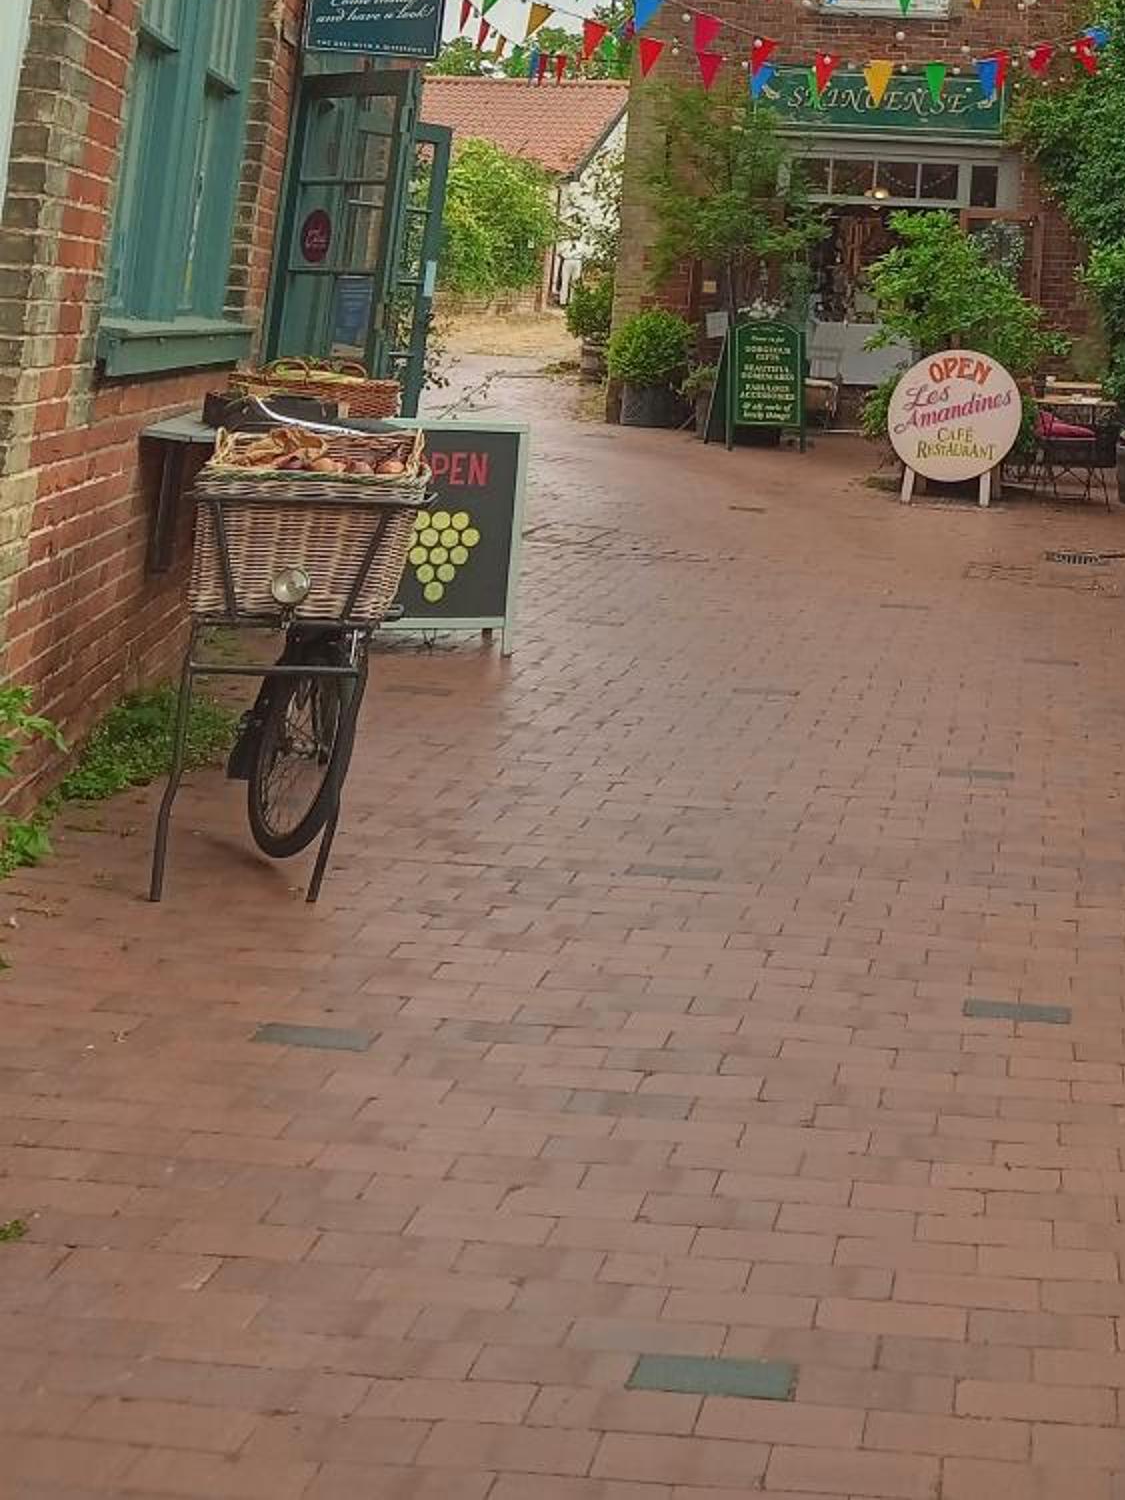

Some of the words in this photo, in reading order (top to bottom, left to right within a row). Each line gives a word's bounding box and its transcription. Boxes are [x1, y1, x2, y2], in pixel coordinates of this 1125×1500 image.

[316, 8, 345, 22] and
[346, 7, 381, 21] have
[928, 356, 992, 387] OPEN
[894, 389, 1013, 434] Amandines
[902, 383, 951, 411] Les
[916, 440, 995, 461] RESTAURANT
[420, 451, 489, 485] PEN
